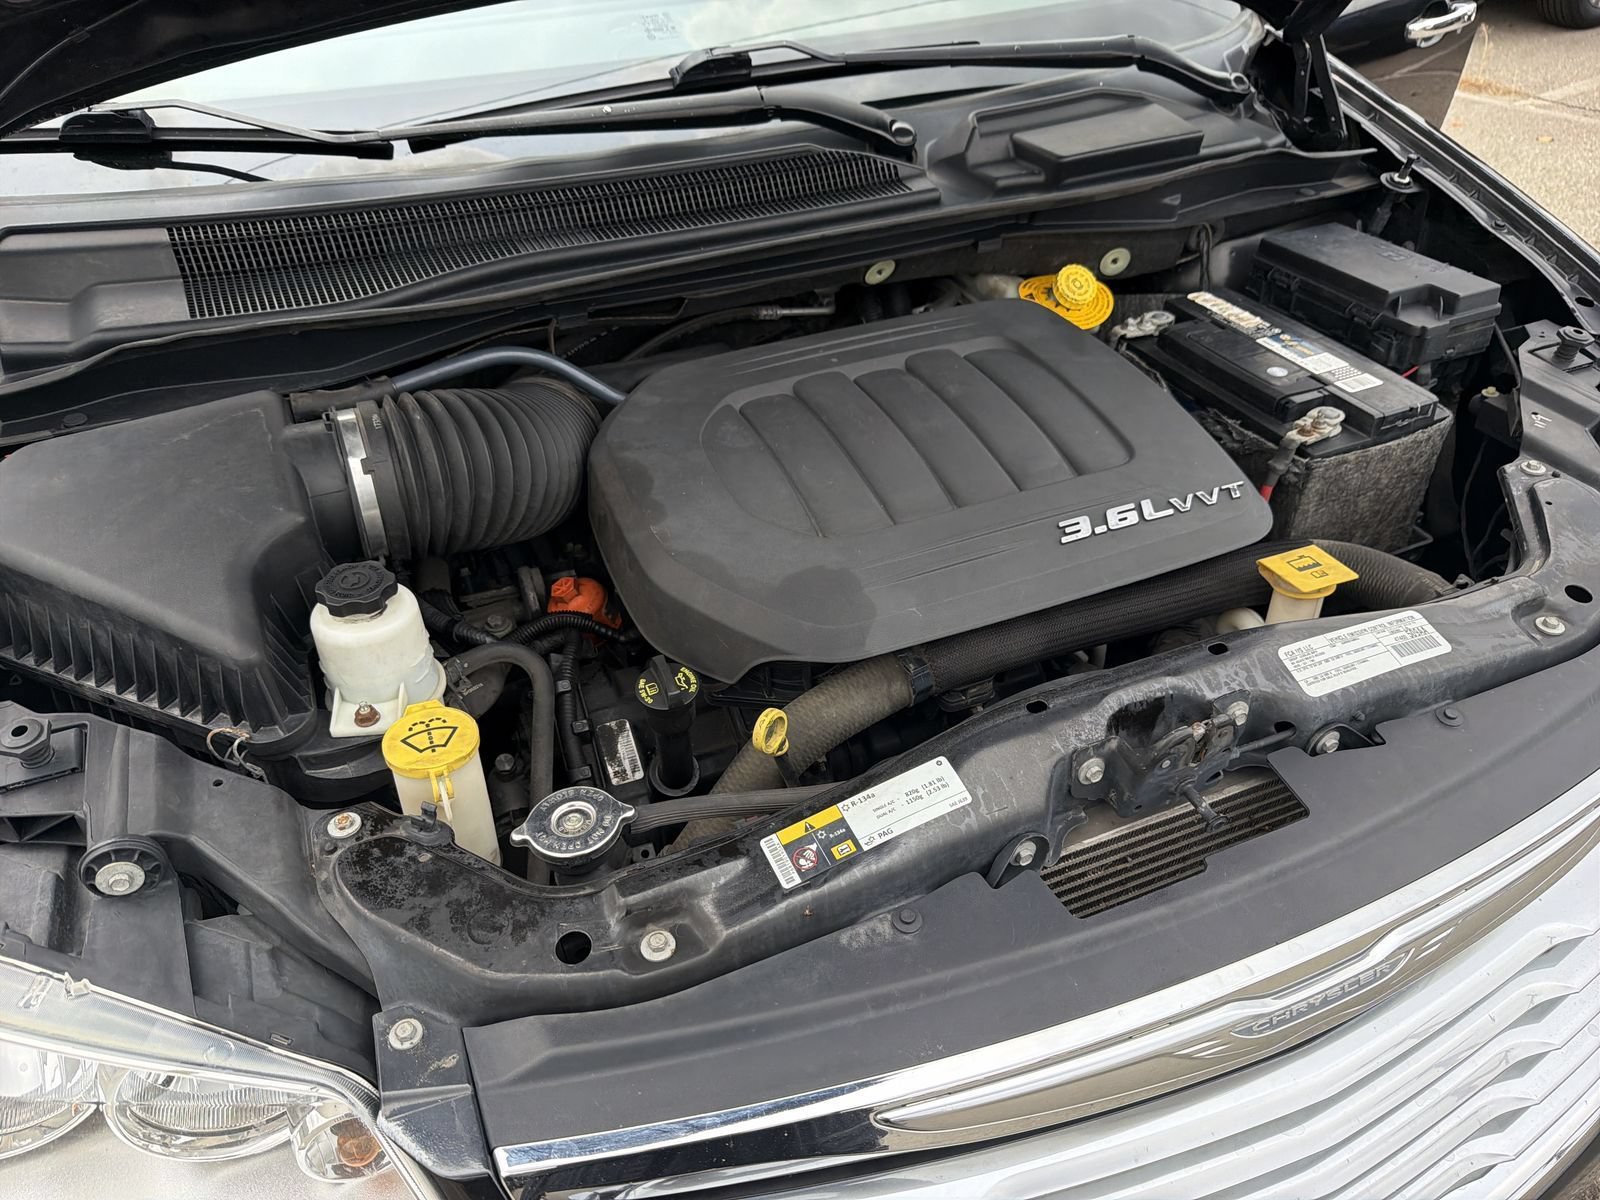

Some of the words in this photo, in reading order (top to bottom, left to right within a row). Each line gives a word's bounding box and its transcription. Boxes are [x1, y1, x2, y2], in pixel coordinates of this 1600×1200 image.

[1058, 498, 1174, 545] 3.6L
[1169, 480, 1244, 512] VVT
[1284, 649, 1295, 657] FCA
[680, 666, 697, 683] ENGINE
[688, 684, 698, 693] OIL
[904, 787, 920, 798] 820g
[921, 778, 936, 790] (1.81
[936, 775, 946, 784] lb)
[905, 794, 924, 805] 1150g
[926, 785, 941, 797] (2.53
[940, 782, 950, 791] lb)
[580, 788, 605, 802] OPEN
[850, 792, 876, 807] R-134a
[877, 828, 894, 839] PAG
[1252, 963, 1391, 1032] CHRYSLER
